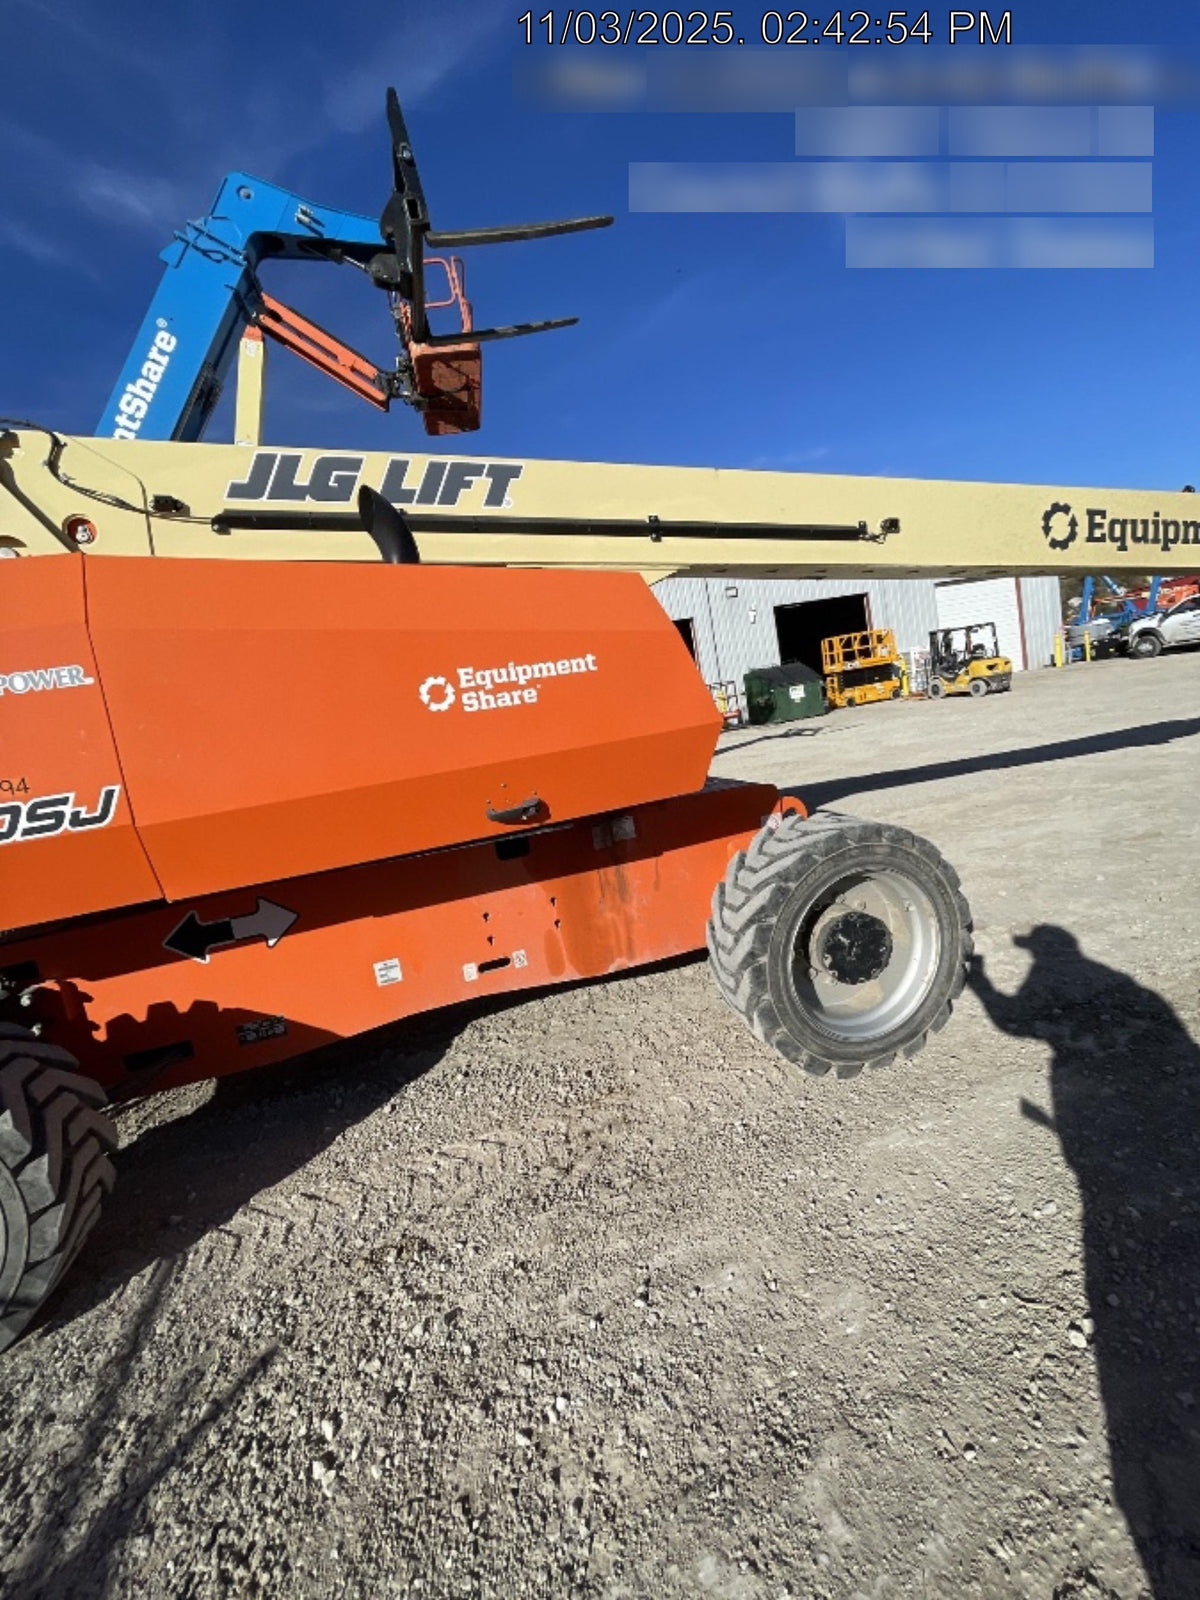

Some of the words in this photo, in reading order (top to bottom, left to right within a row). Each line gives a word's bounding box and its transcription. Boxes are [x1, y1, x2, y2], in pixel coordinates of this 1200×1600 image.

[225, 451, 365, 503] JLG
[380, 457, 524, 507] LIFT
[456, 652, 598, 690] Equipment
[461, 688, 539, 712] Share
